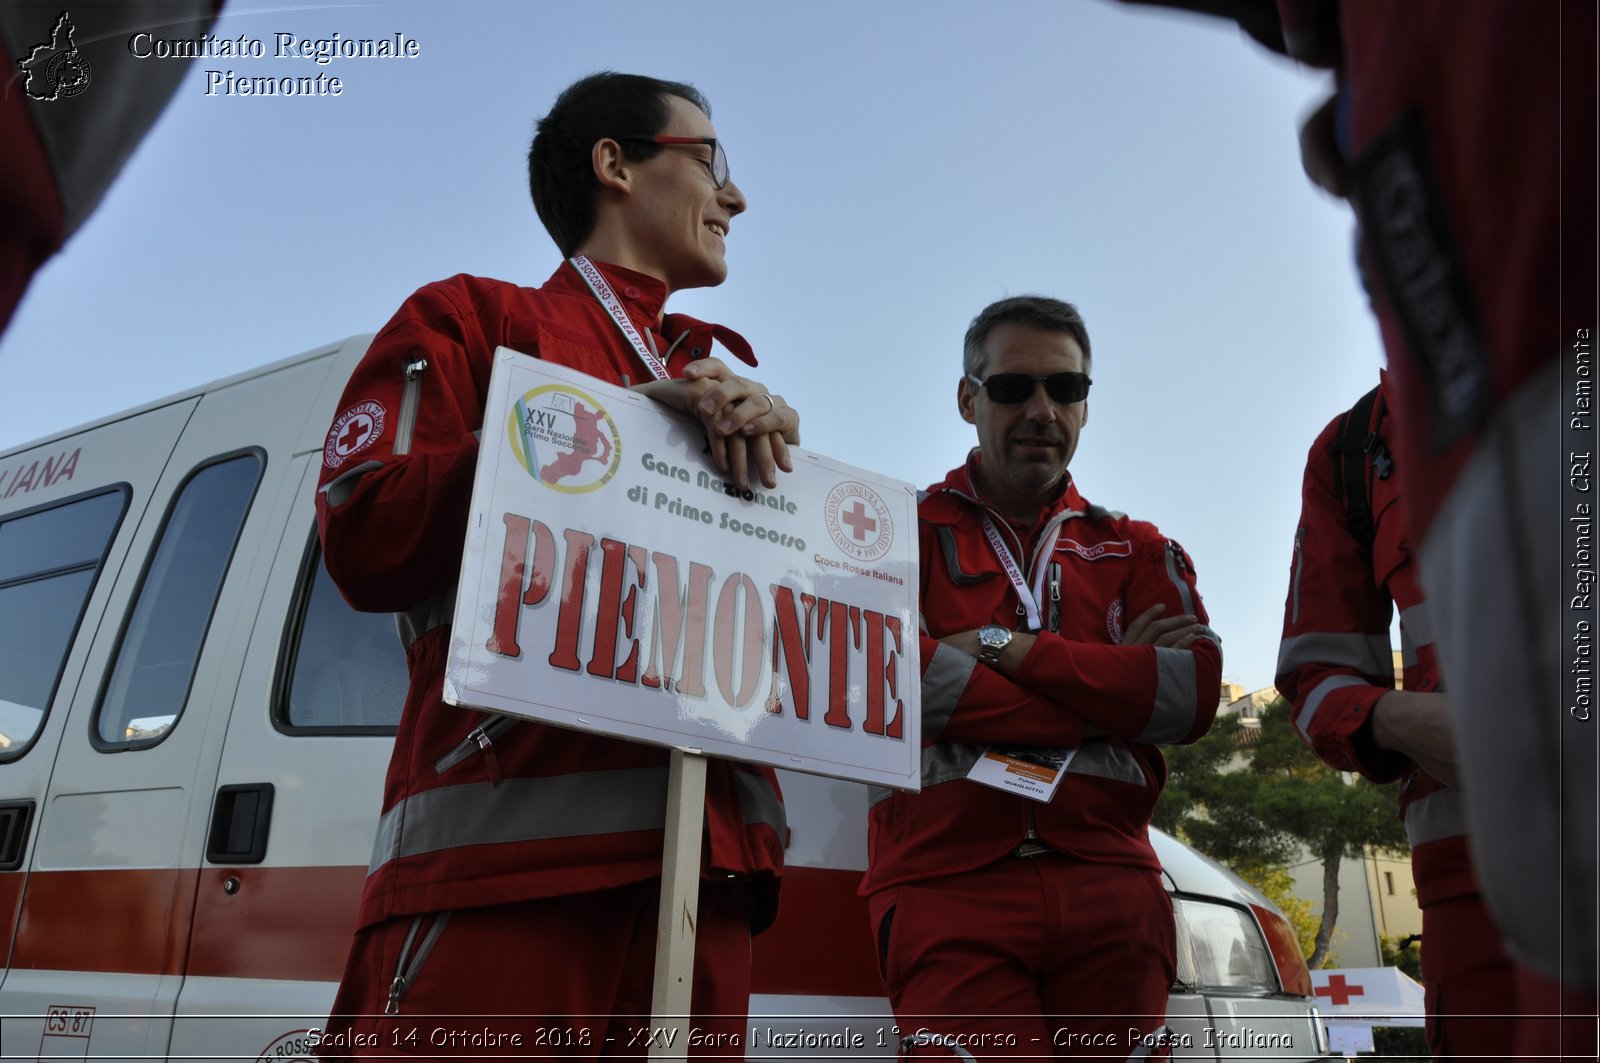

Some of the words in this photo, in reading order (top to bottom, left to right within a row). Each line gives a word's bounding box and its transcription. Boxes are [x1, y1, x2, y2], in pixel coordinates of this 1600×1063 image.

[581, 261, 611, 300] SOCCORSO
[609, 304, 635, 336] SCALEA
[631, 336, 643, 346] 13
[525, 407, 557, 429] XXV
[524, 422, 545, 434] Gara
[547, 429, 588, 446] Nazionale
[524, 429, 549, 442] Primo
[551, 437, 591, 453] Soccorso
[641, 453, 691, 483] Gara
[696, 470, 798, 515] Nazionale
[836, 486, 845, 498] DI
[845, 484, 879, 506] GINEVRA
[626, 485, 648, 506] di
[654, 492, 714, 525] Primo
[719, 512, 807, 552] Soccorso
[827, 494, 855, 554] CONVENZIONE
[876, 505, 886, 516] 22
[880, 518, 891, 551] AGOSTO
[814, 553, 841, 569] Croce
[842, 561, 871, 577] Rossa
[872, 569, 904, 586] Italiana
[988, 530, 998, 540] 13
[993, 540, 1014, 569] OTTOBRE
[1009, 569, 1023, 587] 2018
[486, 511, 905, 740] PIEMONTE
[1004, 780, 1044, 794] QUAGLIOTTO
[48, 1010, 68, 1032] CS
[72, 1011, 90, 1032] 87
